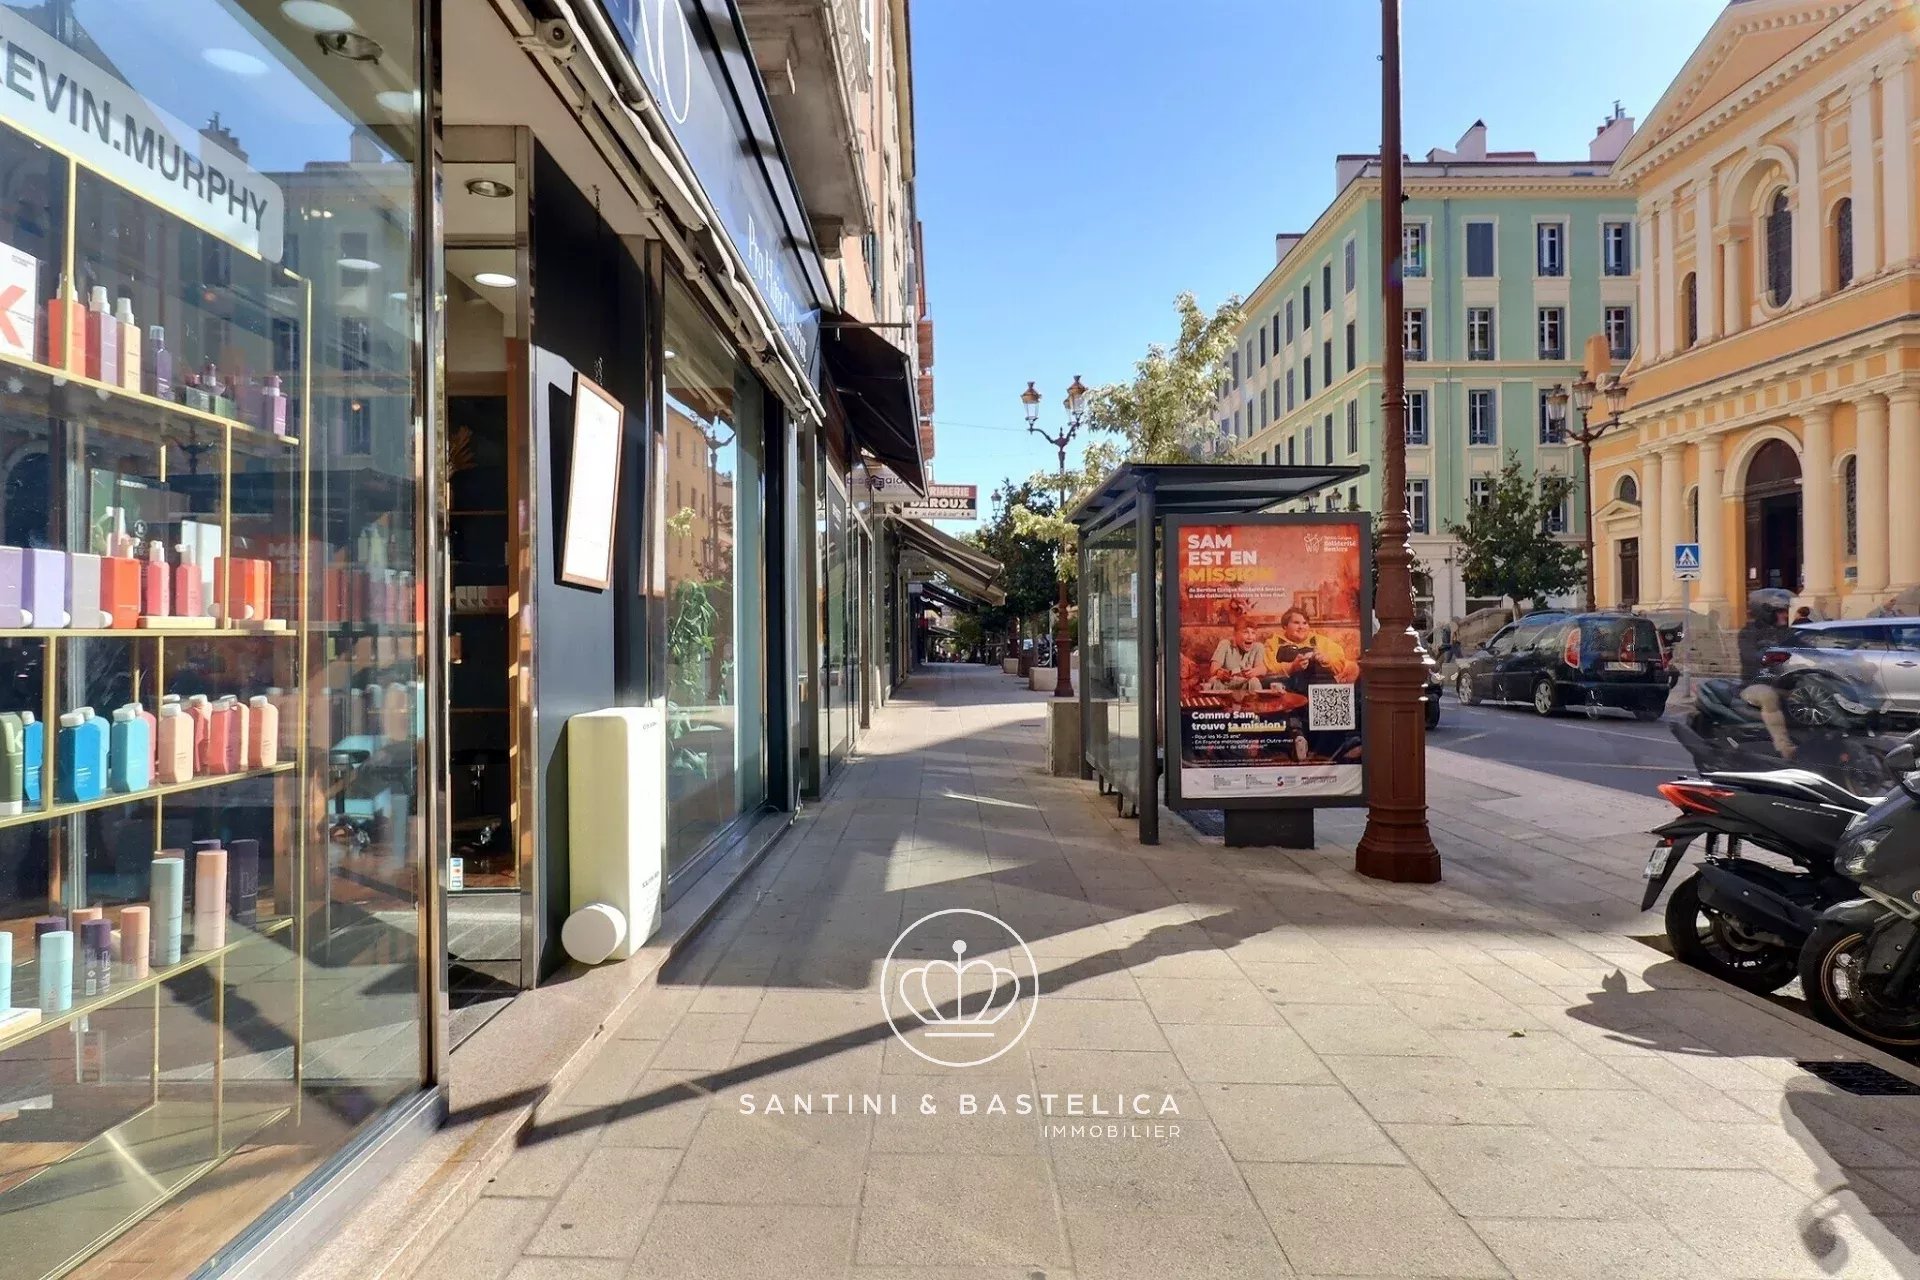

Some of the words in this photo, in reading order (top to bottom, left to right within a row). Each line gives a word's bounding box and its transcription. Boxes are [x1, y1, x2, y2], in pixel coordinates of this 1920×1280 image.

[0, 35, 267, 232] EVIN.MURPHY
[748, 213, 763, 280] Pro
[929, 486, 970, 497] RIMERIE
[1188, 534, 1232, 549] SAM
[1189, 552, 1225, 566] EST
[1230, 551, 1257, 565] EN
[1188, 567, 1273, 582] MISSIO
[1192, 712, 1231, 720] Comme
[1233, 711, 1258, 720] Sam,
[1192, 722, 1226, 731] trouve
[1227, 721, 1239, 729] ta
[1241, 720, 1280, 729] mission
